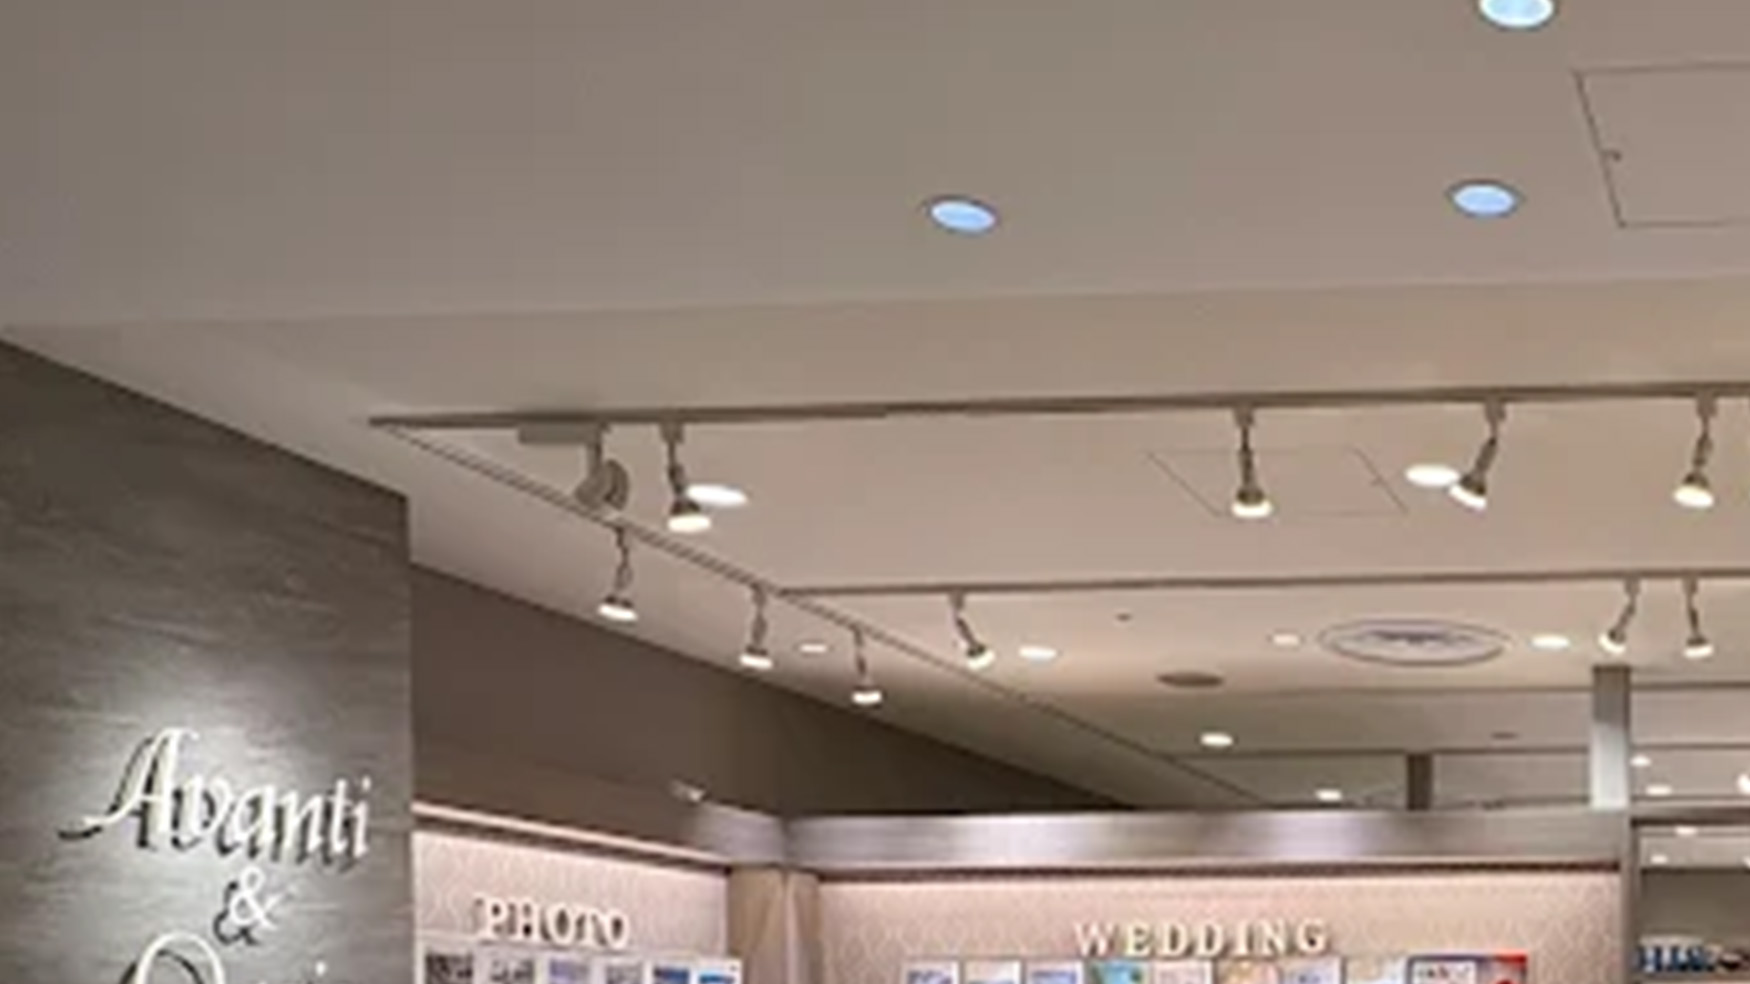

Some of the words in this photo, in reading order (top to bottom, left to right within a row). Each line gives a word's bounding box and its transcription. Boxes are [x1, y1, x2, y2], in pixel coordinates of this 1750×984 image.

[82, 727, 372, 859] Avanti
[226, 866, 296, 928] &
[477, 897, 630, 949] PHOTO
[1074, 917, 1327, 957] WEDDING
